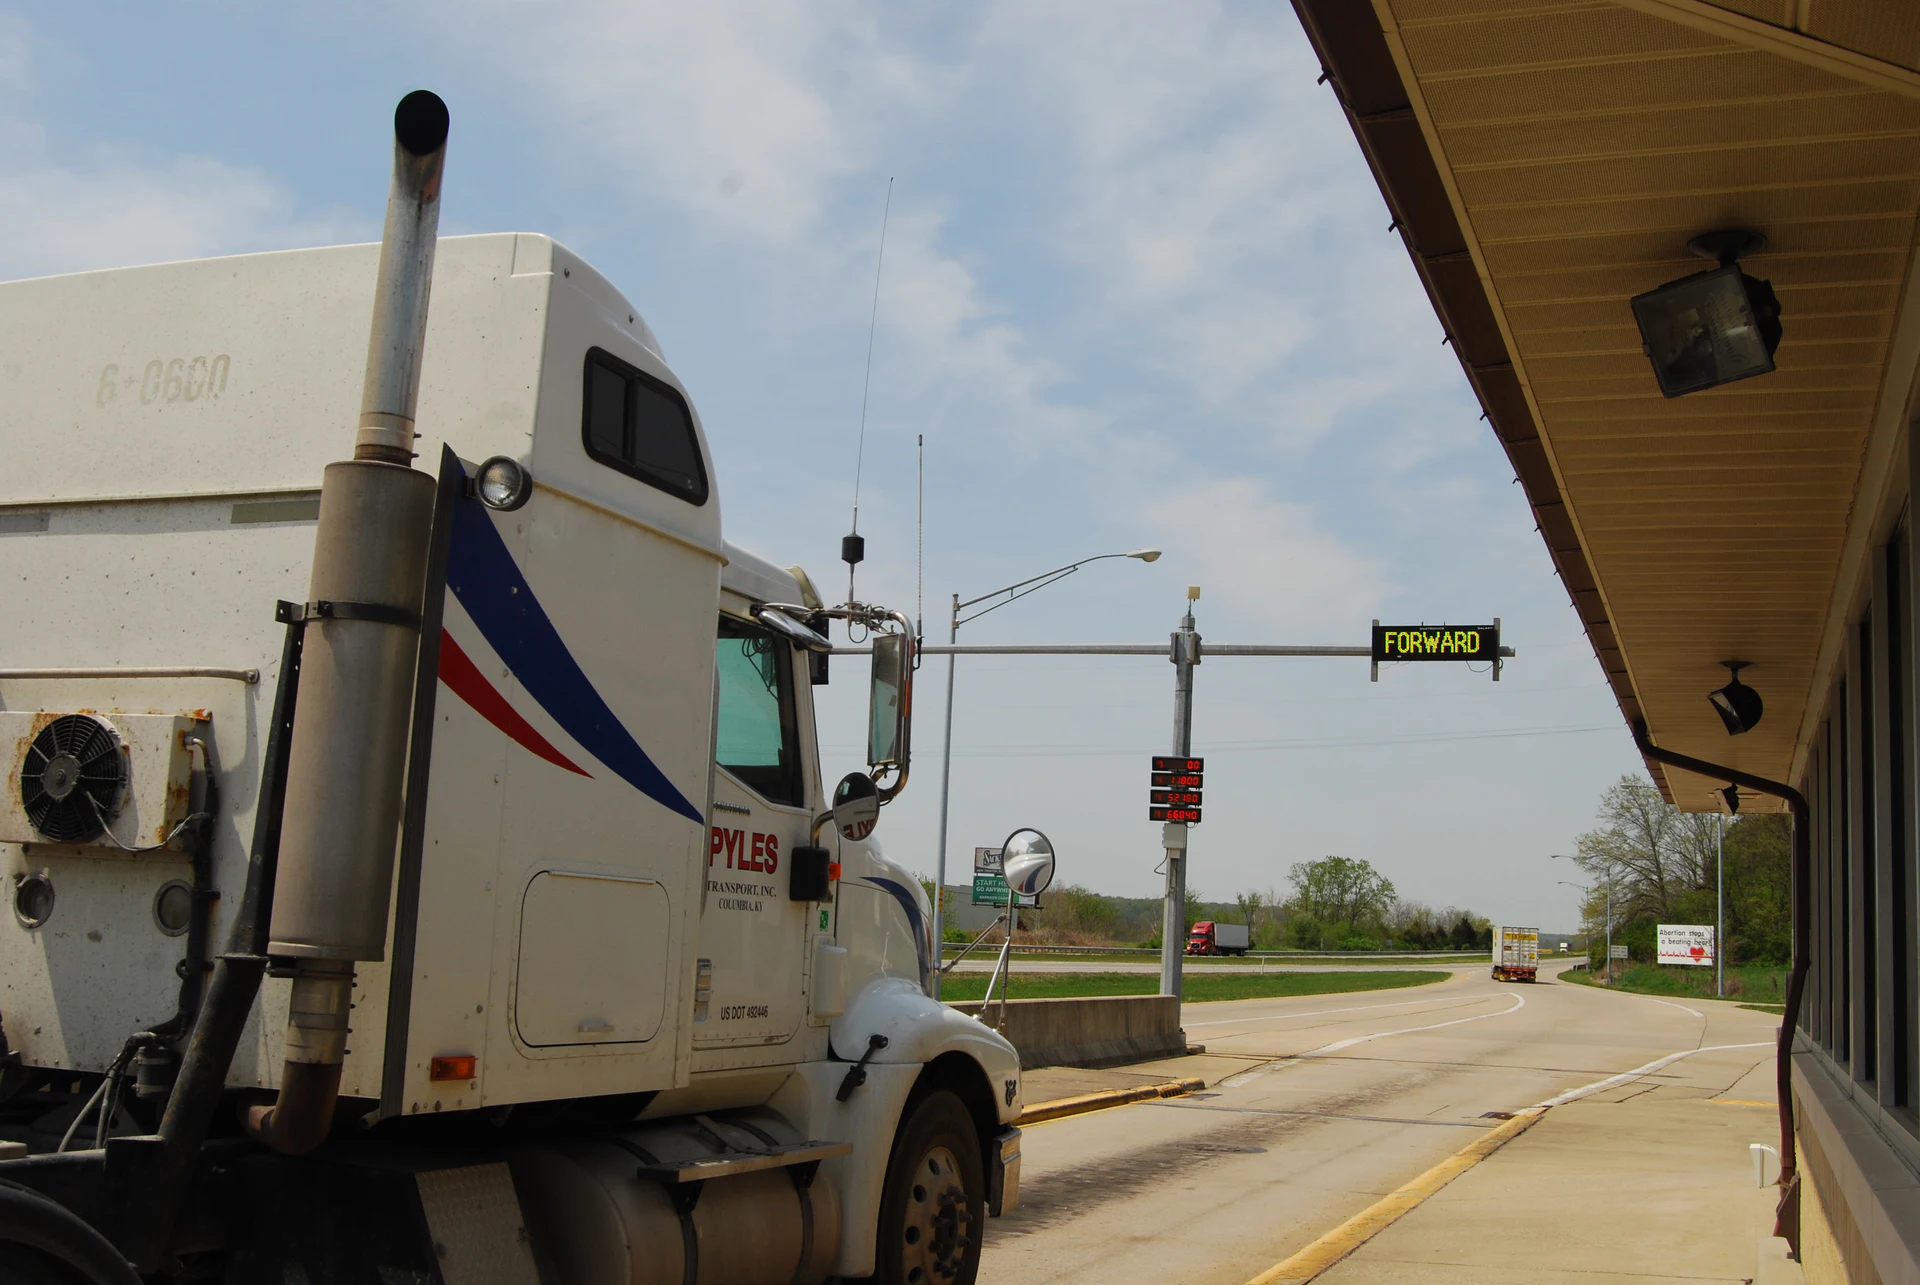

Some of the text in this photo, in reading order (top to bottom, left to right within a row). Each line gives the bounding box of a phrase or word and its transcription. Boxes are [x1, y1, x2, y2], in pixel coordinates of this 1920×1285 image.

[1385, 631, 1480, 653] FORWARD
[709, 826, 779, 875] PYLES
[976, 879, 1007, 888] START HE
[761, 885, 777, 898] INC.
[755, 902, 765, 912] KY
[1659, 929, 1705, 938] Abortion stops
[1668, 937, 1692, 946] beating
[721, 1006, 730, 1020] US
[731, 1005, 746, 1019] DOT
